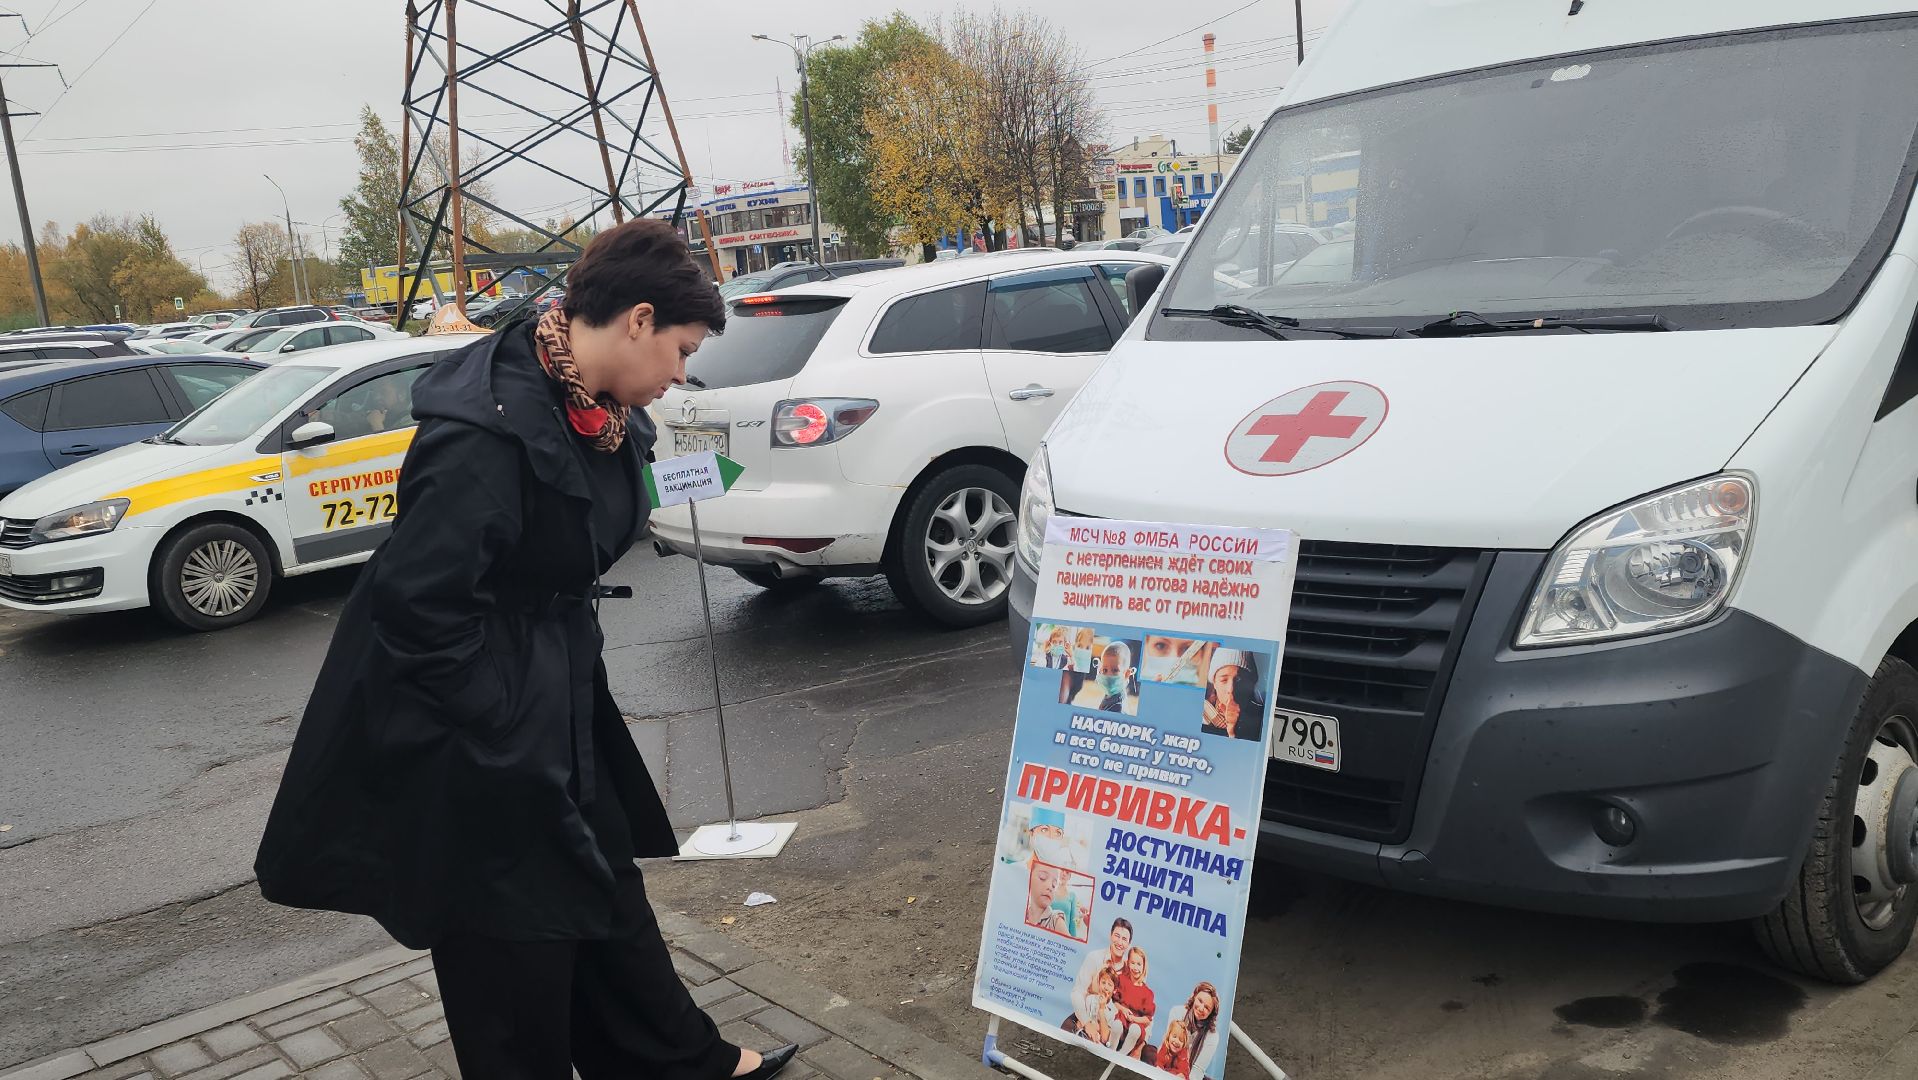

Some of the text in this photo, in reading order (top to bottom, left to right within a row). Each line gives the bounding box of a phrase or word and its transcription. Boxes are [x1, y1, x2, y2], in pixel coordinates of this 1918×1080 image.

[662, 466, 709, 482] БЕСПЛАТНАЯ
[664, 478, 713, 493] ВАКЦИНАЦИЯ
[1070, 527, 1259, 555] МСЧ №8 ФМБА РОССИИ
[1077, 552, 1163, 571] нетерпением
[1167, 553, 1205, 575] ждёт
[1208, 558, 1254, 576] своих
[1056, 571, 1260, 599] пациентов и готова надёжно
[1062, 591, 1245, 621] защитить вас от гриппа!!!
[1070, 715, 1202, 753] НАСМОРК, жар
[1054, 731, 1213, 774] и все болит у того,
[1288, 745, 1314, 760] RUS
[1070, 752, 1192, 787] кто не привит
[1105, 827, 1245, 881] ДОСТУПНАЯ
[1102, 853, 1194, 897] ЗАЩИТА
[1100, 880, 1227, 938] ОТ ГРИППА
